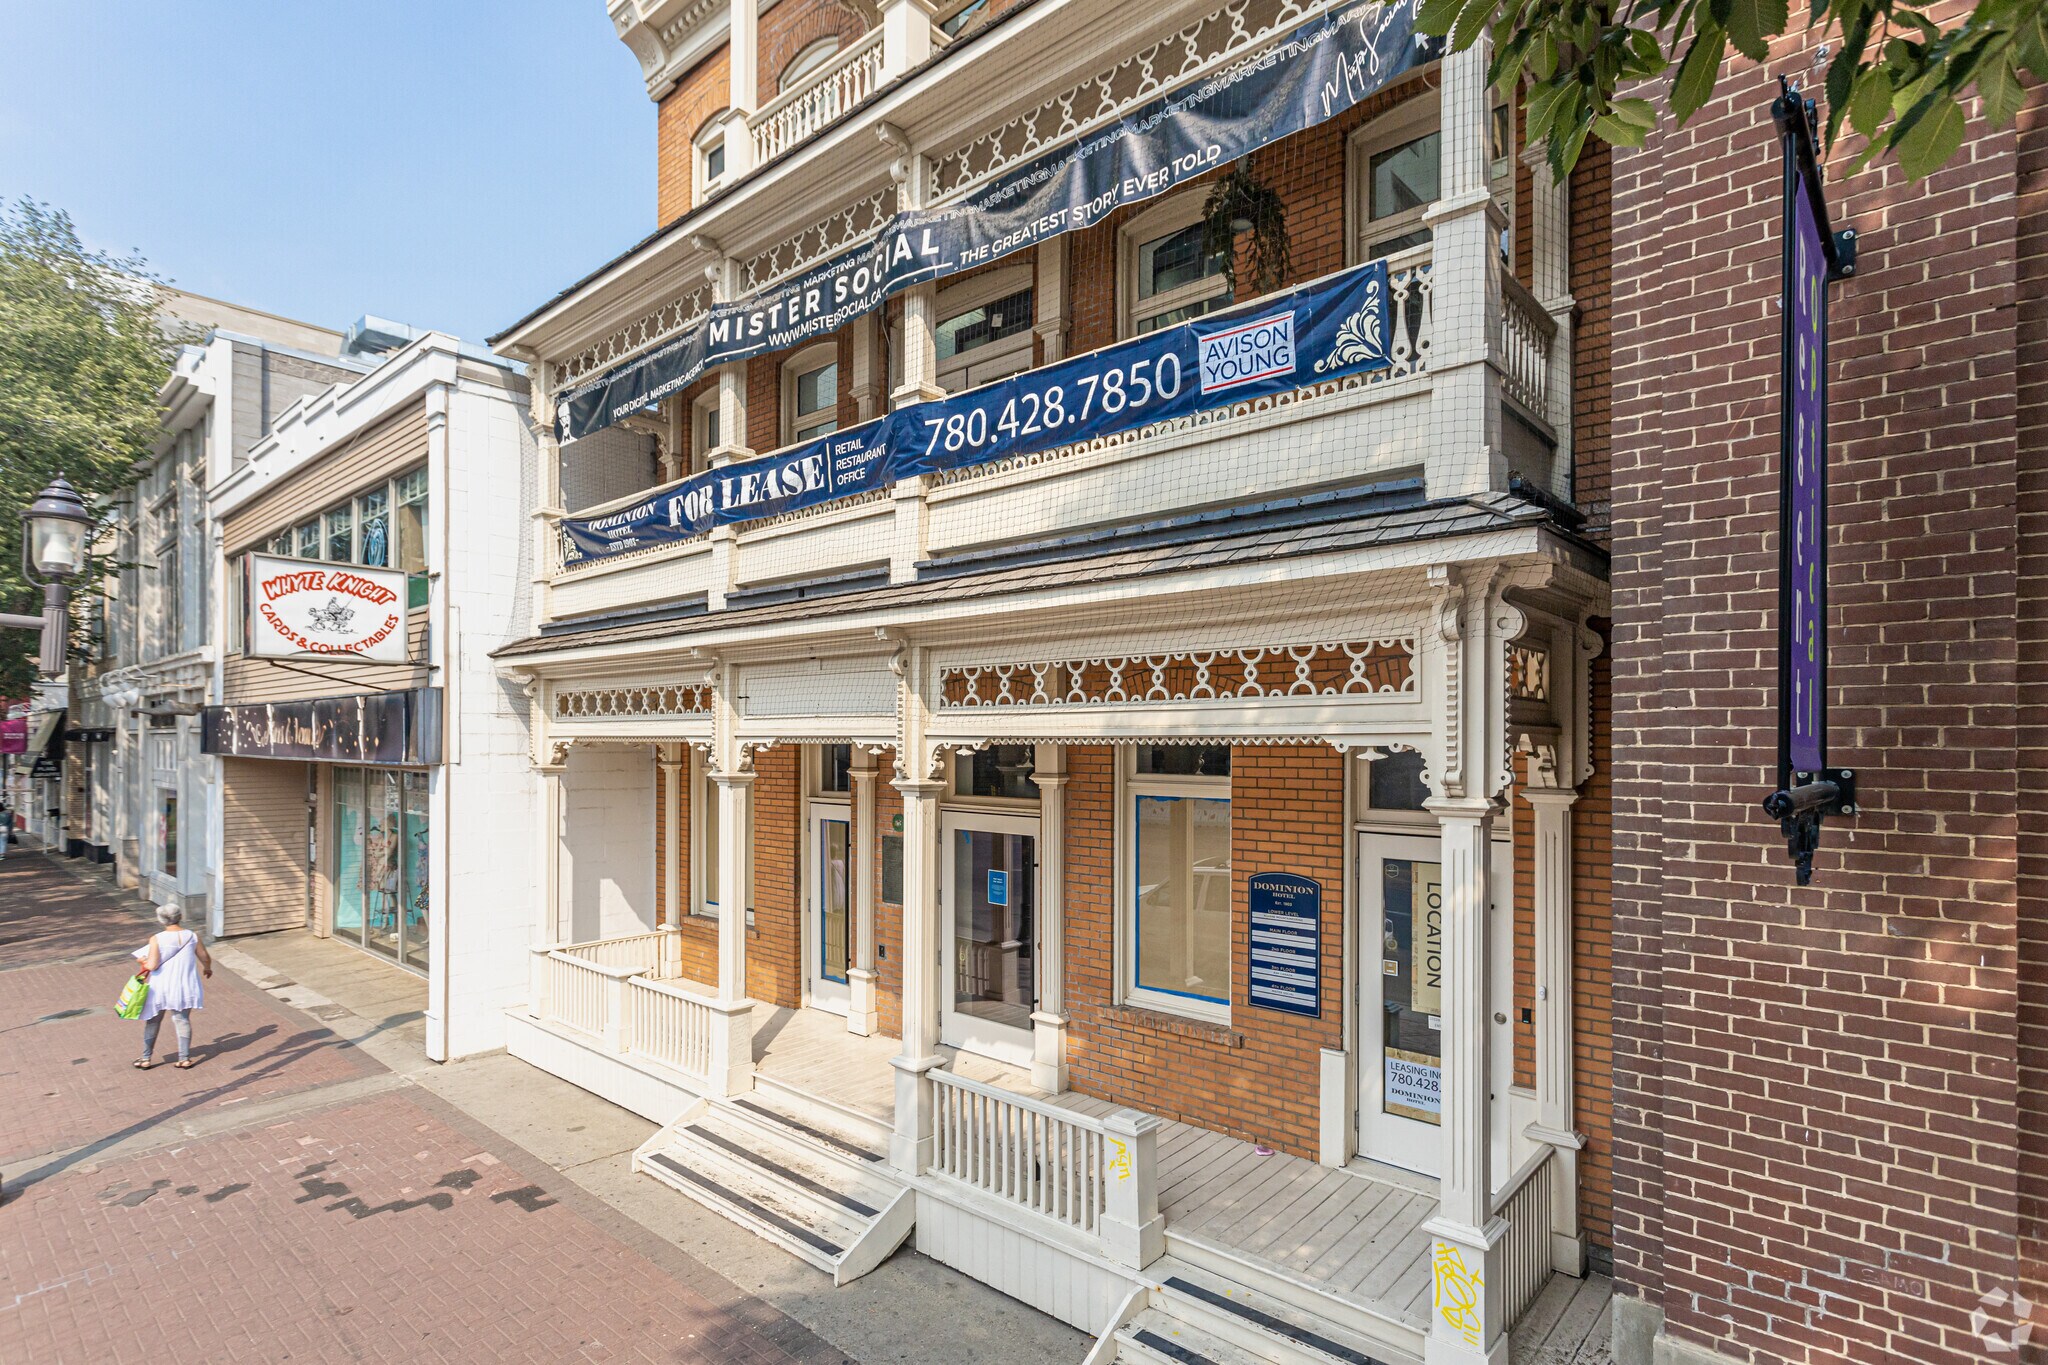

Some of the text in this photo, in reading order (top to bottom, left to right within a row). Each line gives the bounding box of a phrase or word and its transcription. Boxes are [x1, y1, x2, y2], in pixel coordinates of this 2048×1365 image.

[959, 144, 1222, 266] THE GREATEST STORY EVER TOLD
[709, 228, 940, 347] MISTER SOCIAL
[803, 257, 855, 288] MARKETING
[768, 287, 882, 347] WWW.MISTERSOCIAL.CA
[1205, 322, 1290, 362] AVISON
[1205, 346, 1291, 382] YOUNG
[612, 401, 630, 418] YOUR
[650, 374, 686, 400] MARKETING
[924, 351, 1182, 457] 780.428.7850
[835, 438, 864, 456] RETAIL
[836, 443, 886, 471] RESTAURANT
[668, 453, 826, 528] FOR LEASE
[837, 467, 866, 486] OFFICE
[588, 501, 657, 532] DOMINION
[1807, 275, 1818, 738] optical
[607, 525, 633, 539] HOTEL
[262, 571, 397, 605] WHYTE KNIGHT
[260, 603, 399, 656] CARDS & COLLECTABLES
[1254, 881, 1314, 895] DOMINION
[1272, 891, 1296, 900] HOTEL
[1427, 882, 1442, 988] LOCATION
[1390, 1061, 1428, 1077] LEASING
[1391, 1088, 1441, 1104] DOMINION
